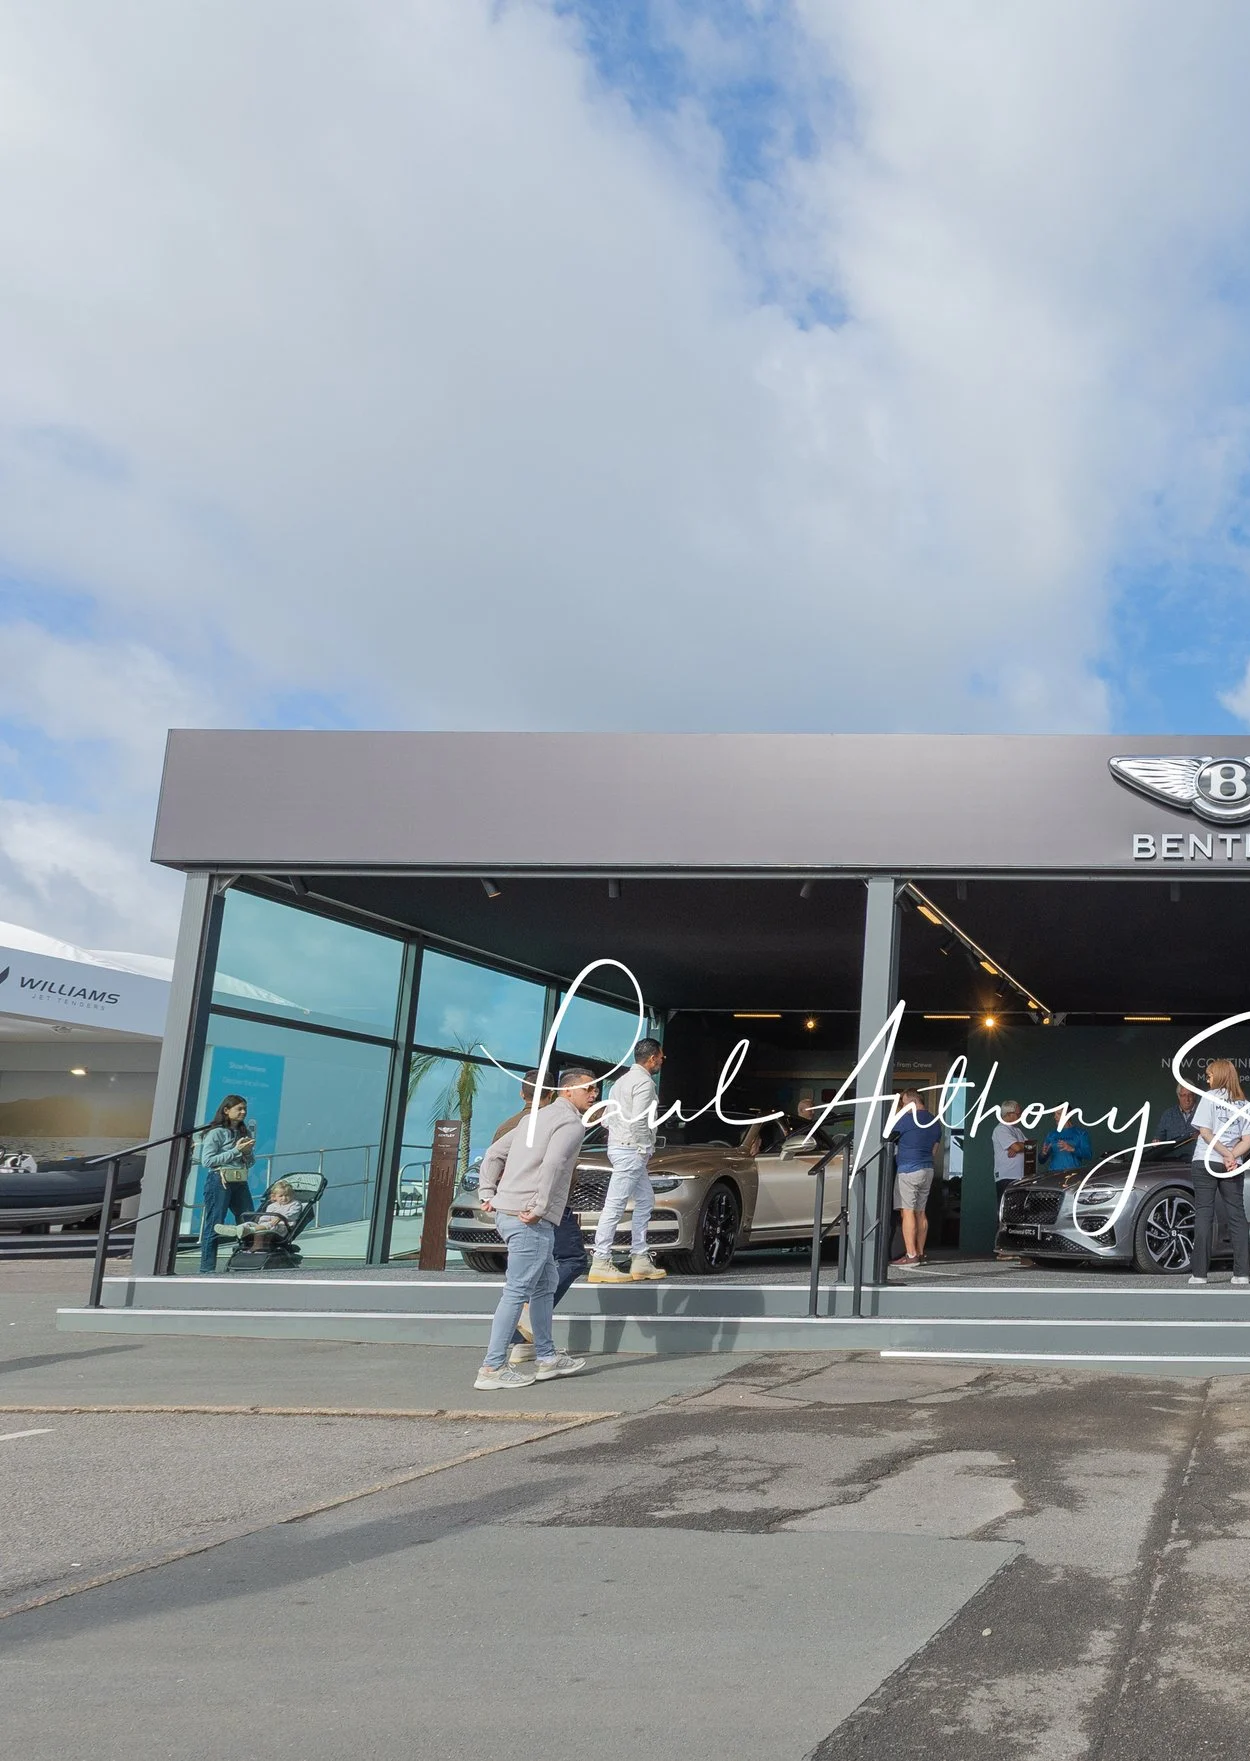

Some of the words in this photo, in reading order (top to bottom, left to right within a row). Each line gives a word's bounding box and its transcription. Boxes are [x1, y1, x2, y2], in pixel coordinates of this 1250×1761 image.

[1209, 763, 1248, 801] B
[20, 976, 120, 1005] WILLIAMS
[31, 993, 52, 1001] JET
[57, 997, 105, 1011] TENDERS
[1161, 1058, 1194, 1068] NW
